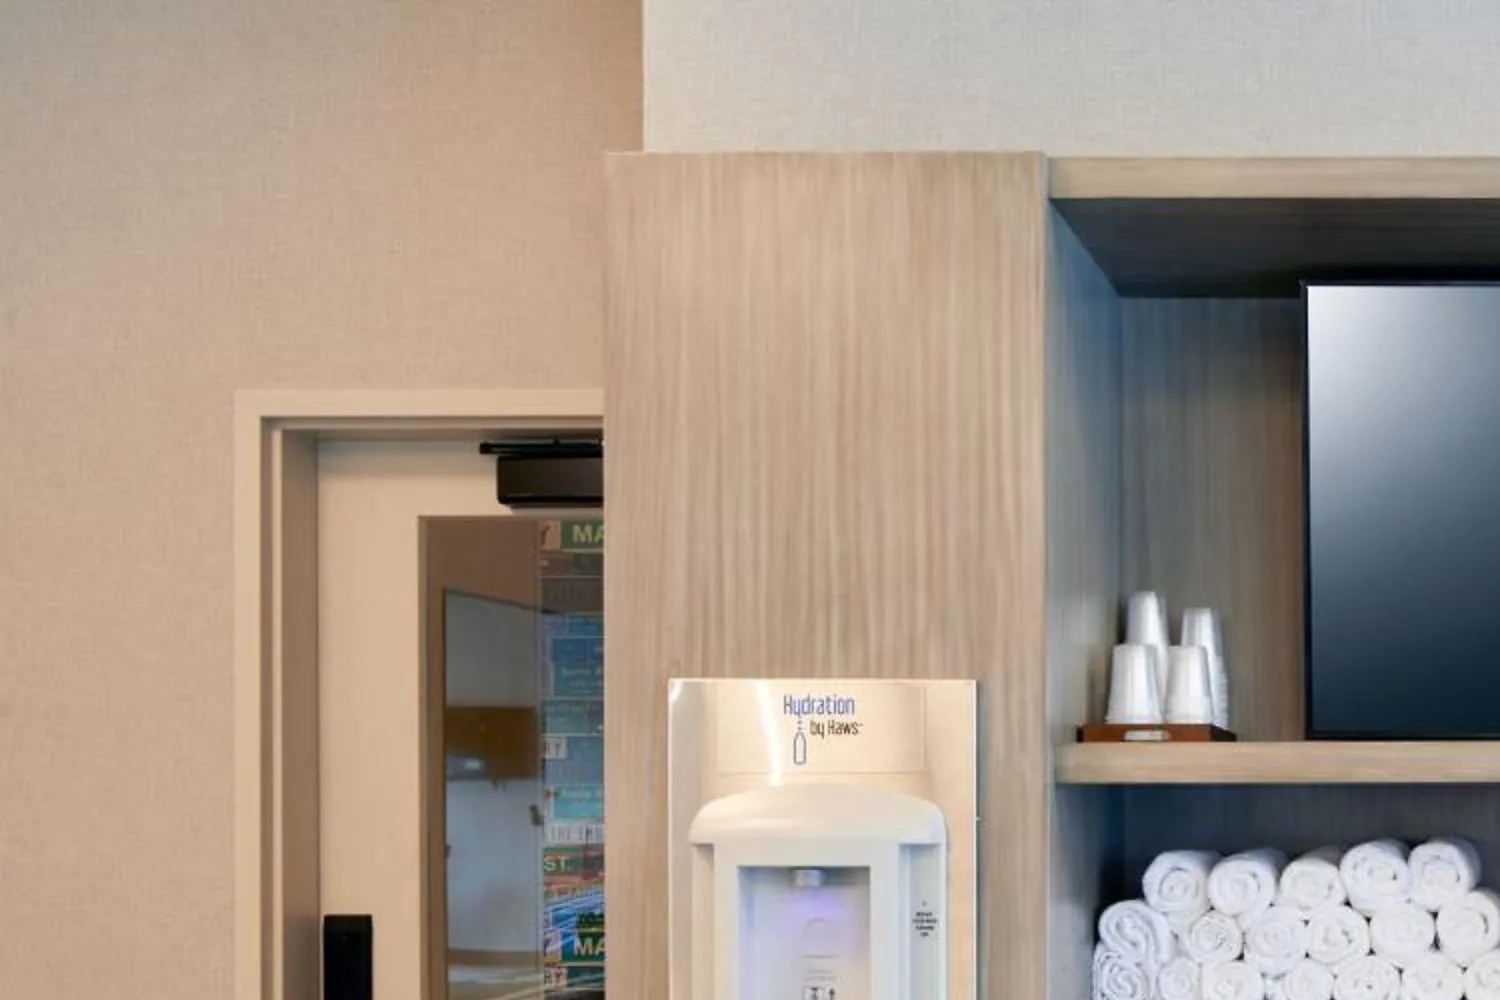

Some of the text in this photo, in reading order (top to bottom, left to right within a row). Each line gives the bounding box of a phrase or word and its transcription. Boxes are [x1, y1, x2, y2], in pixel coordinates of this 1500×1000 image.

[783, 694, 855, 717] Hydration
[809, 719, 860, 739] by Haws
